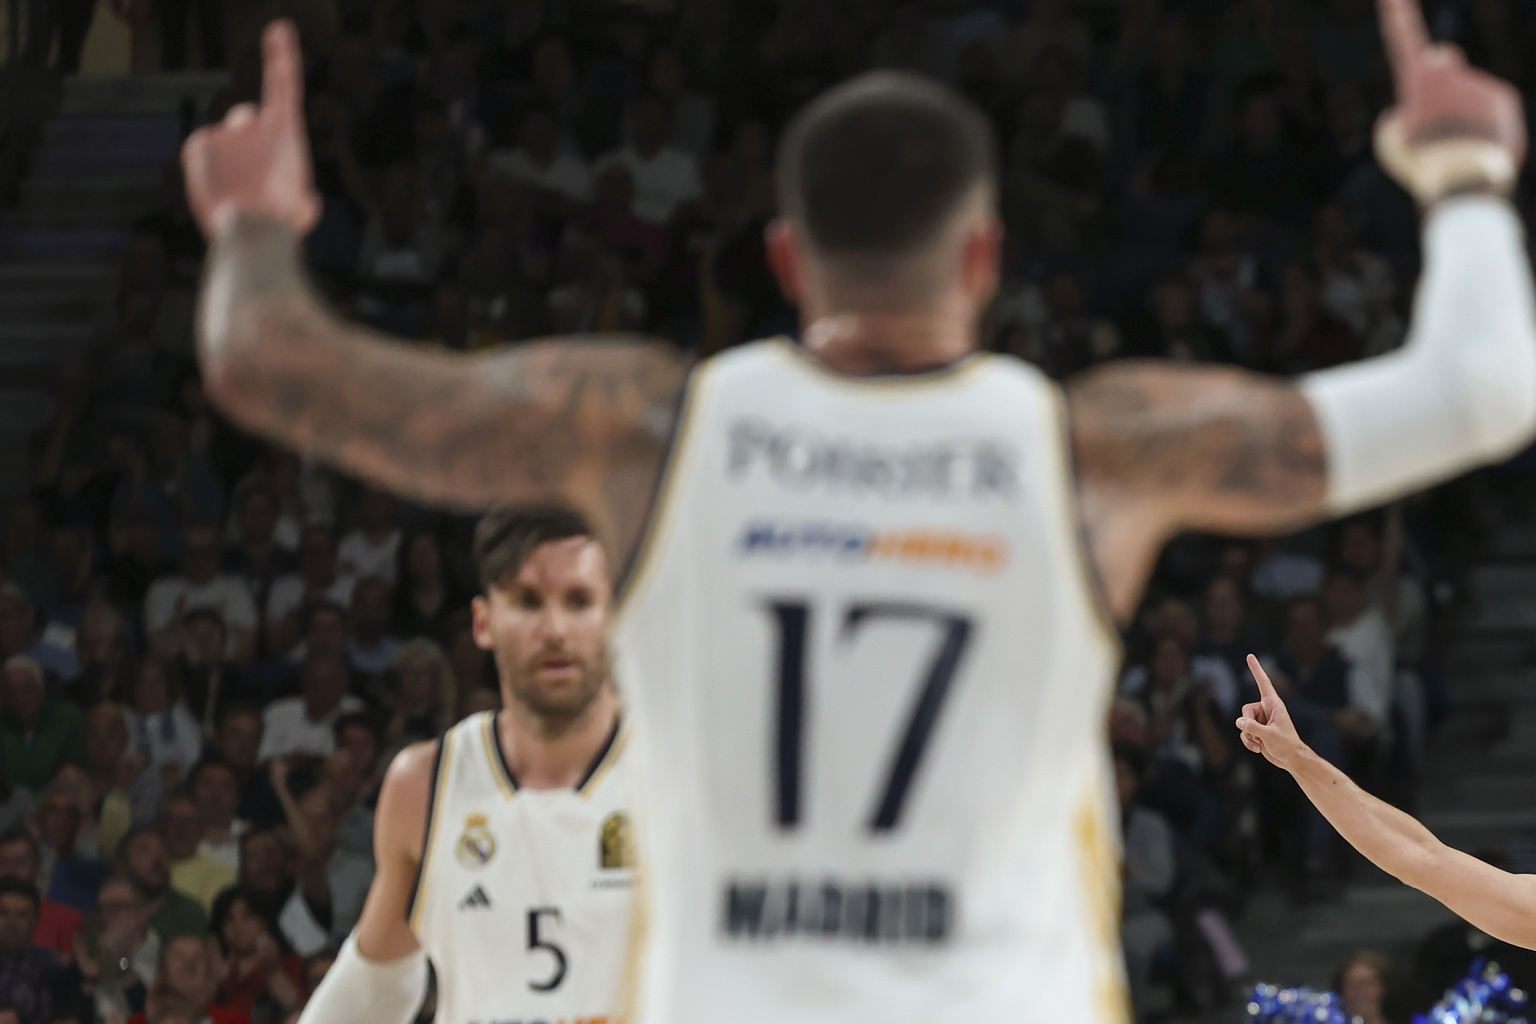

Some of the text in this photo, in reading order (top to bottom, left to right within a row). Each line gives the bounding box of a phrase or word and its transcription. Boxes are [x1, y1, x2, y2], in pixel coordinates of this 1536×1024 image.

[757, 597, 979, 836] 17
[525, 906, 569, 993] 5
[719, 872, 957, 944] MADRID
